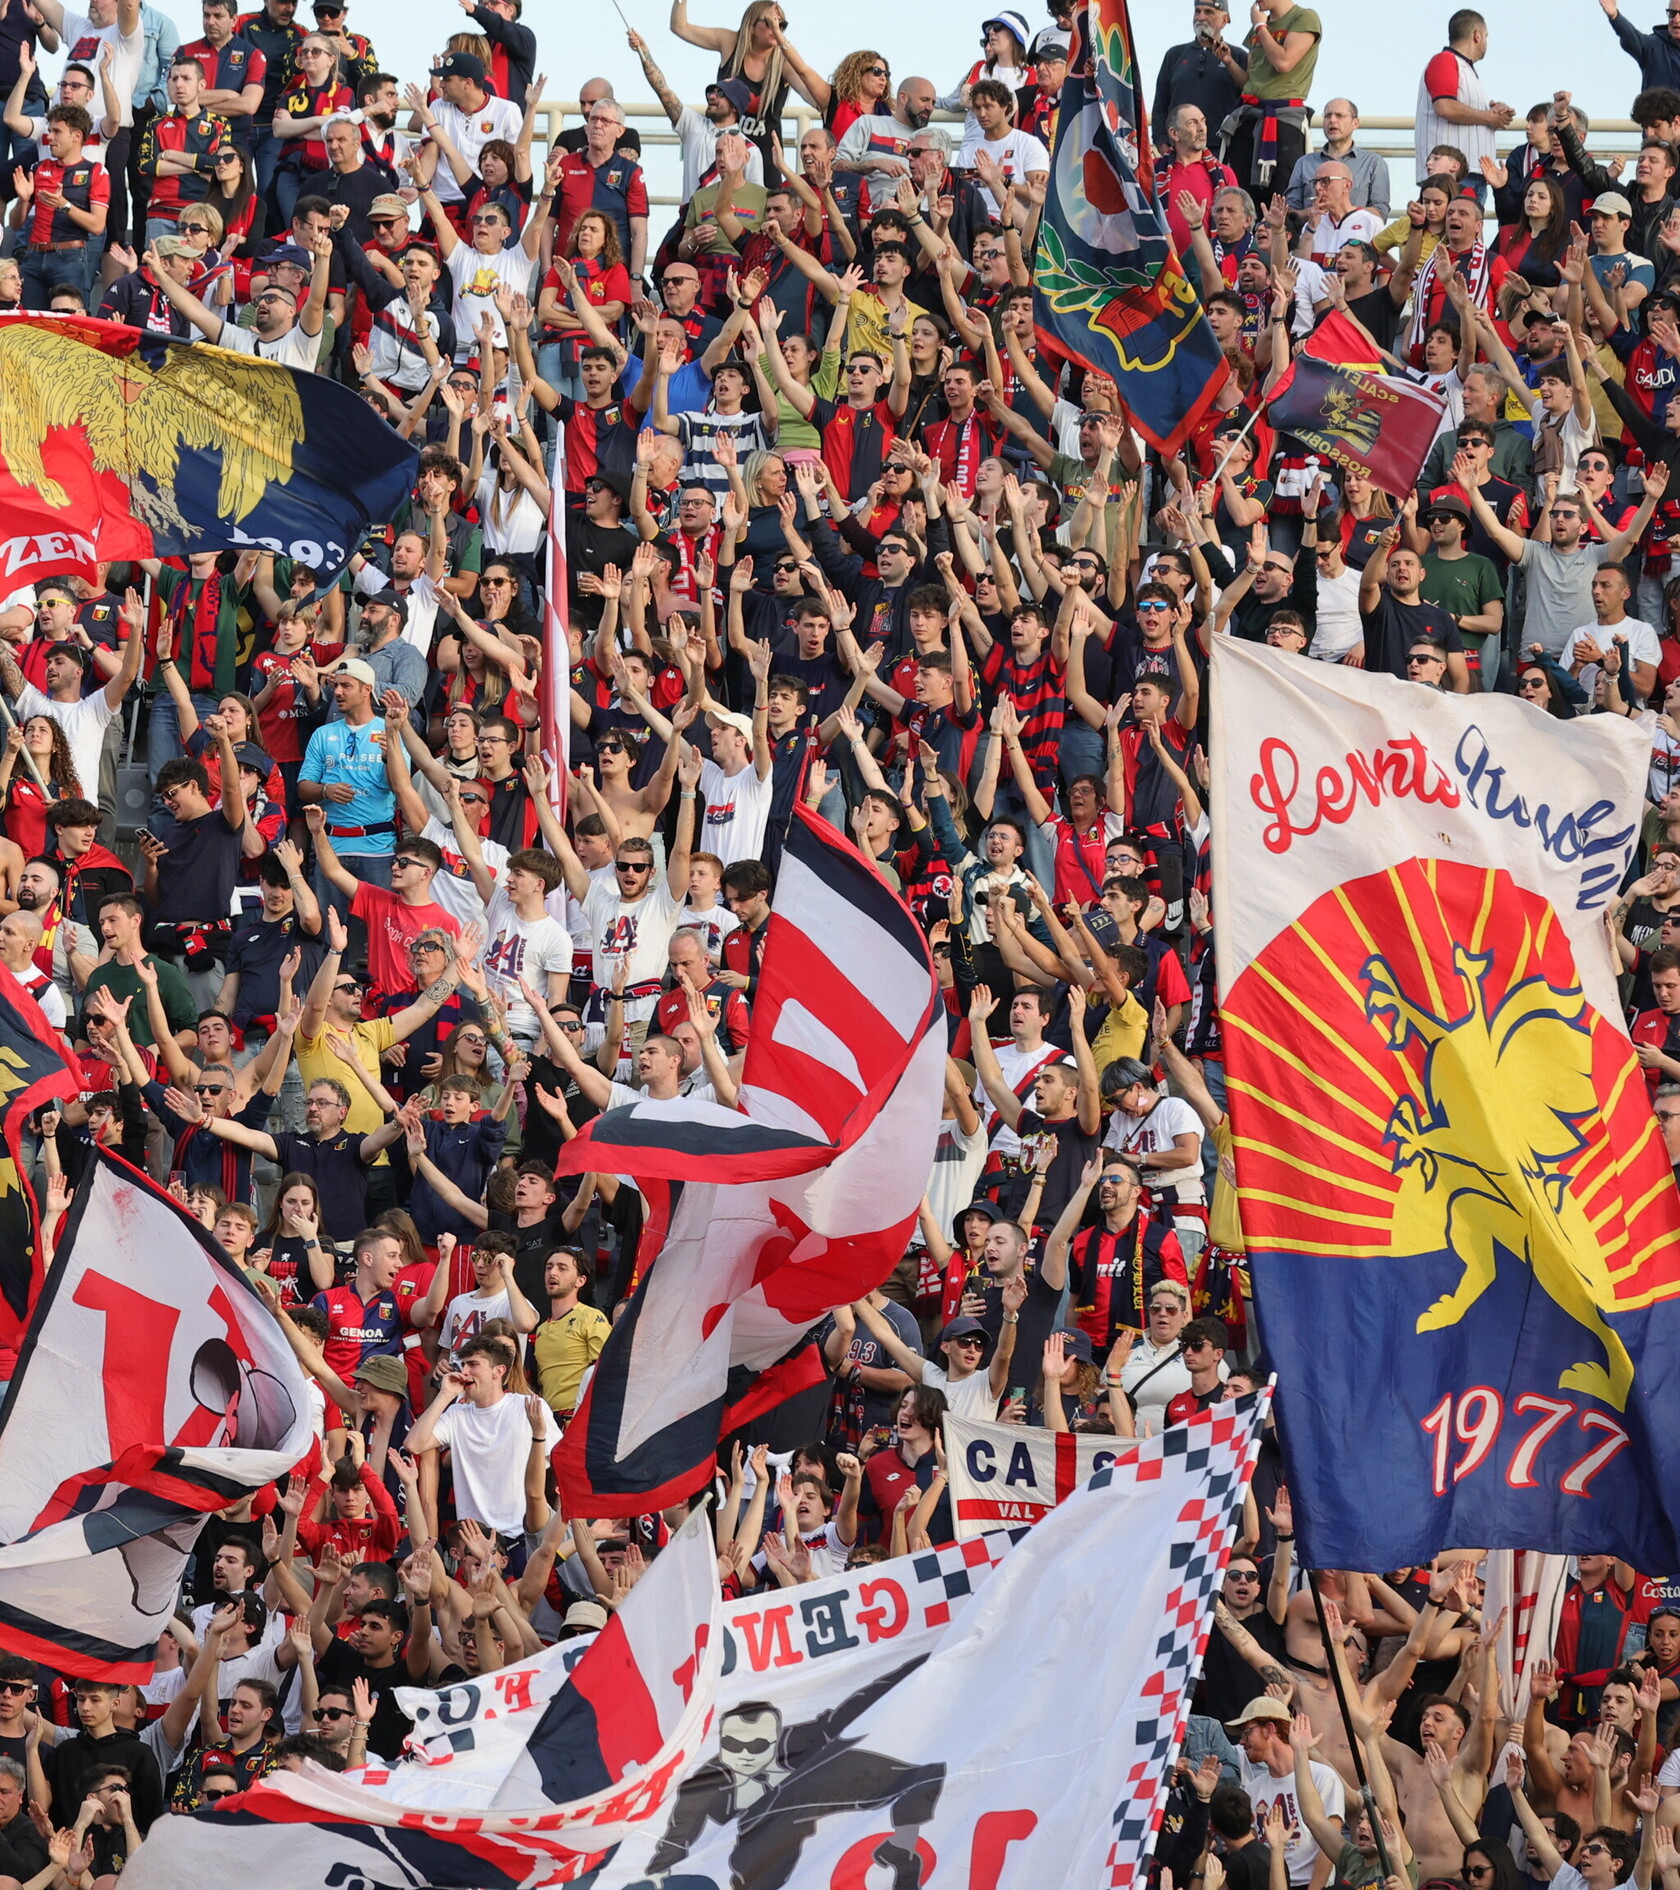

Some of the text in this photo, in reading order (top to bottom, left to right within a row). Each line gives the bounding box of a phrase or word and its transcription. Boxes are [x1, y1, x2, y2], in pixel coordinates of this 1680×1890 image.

[339, 1327, 384, 1338] GENOA
[1421, 1386, 1631, 1498] 1977
[997, 1502, 1035, 1519] VAL
